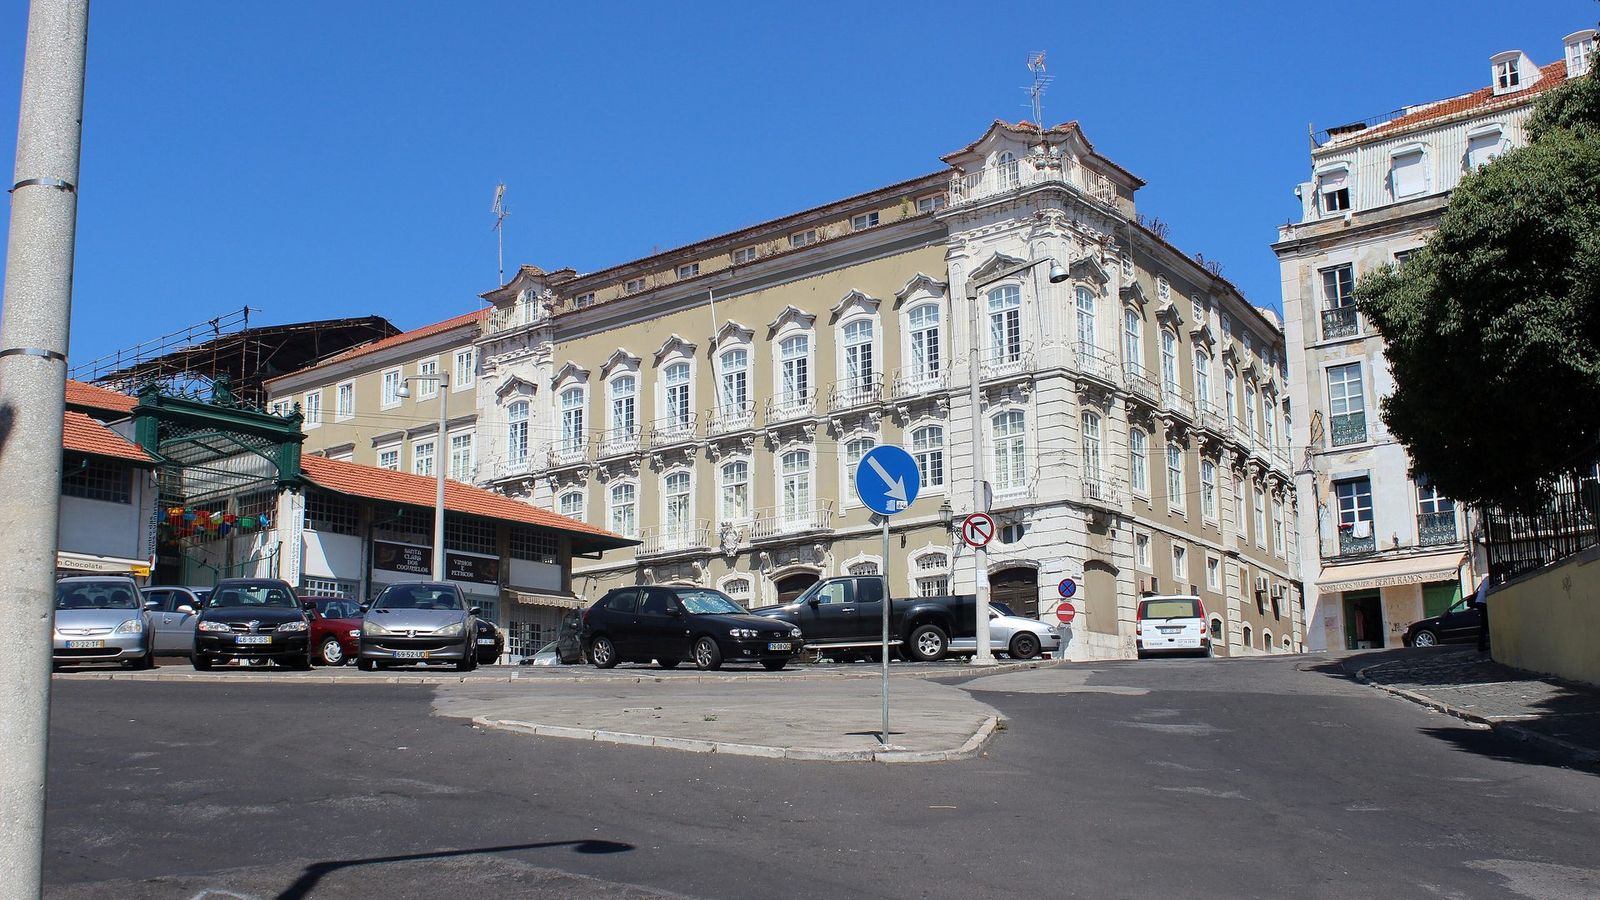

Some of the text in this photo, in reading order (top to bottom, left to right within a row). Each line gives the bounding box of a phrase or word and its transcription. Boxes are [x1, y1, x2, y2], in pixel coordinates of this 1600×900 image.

[64, 560, 103, 570] Chocolate
[1375, 577, 1395, 586] BERTA
[1397, 574, 1423, 584] RAMOS
